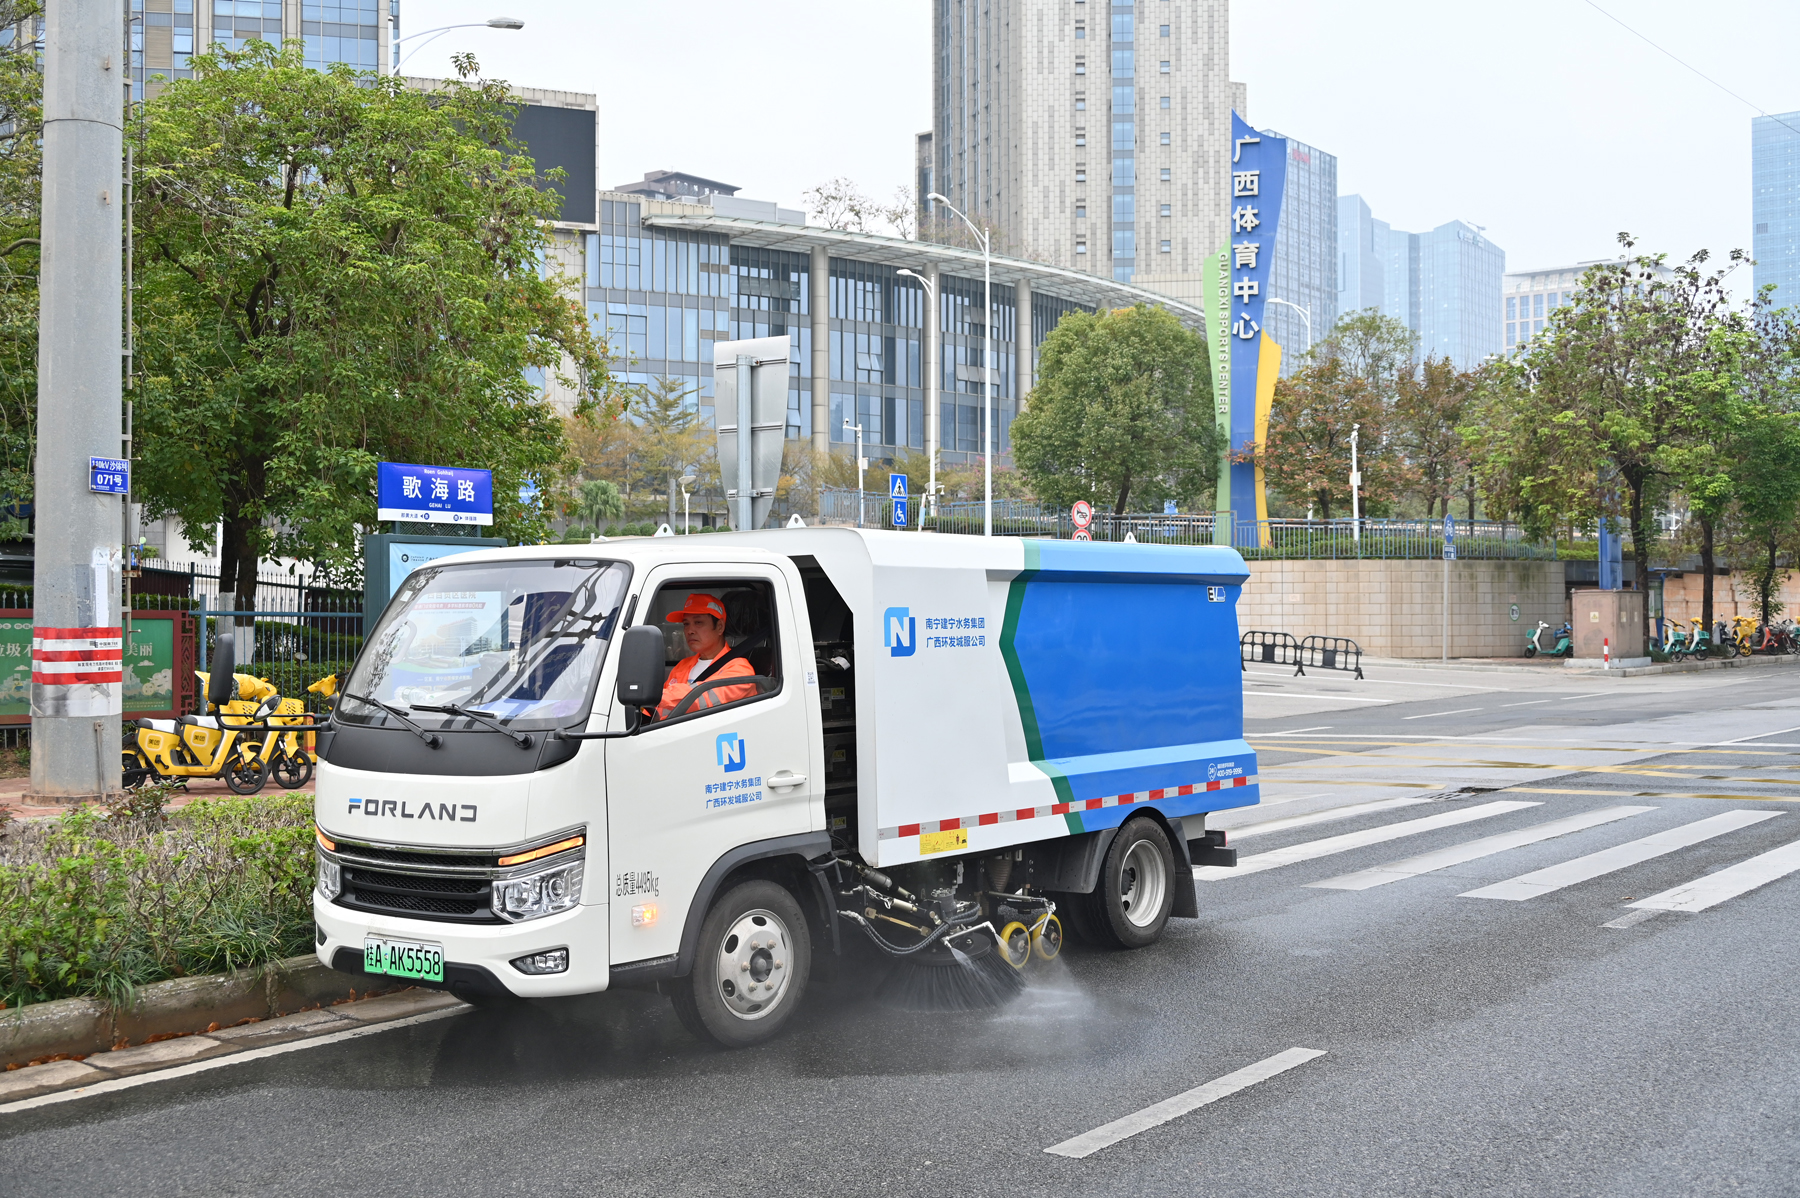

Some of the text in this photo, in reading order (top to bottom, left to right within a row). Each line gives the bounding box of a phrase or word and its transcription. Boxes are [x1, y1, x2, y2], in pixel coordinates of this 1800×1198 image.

[1232, 134, 1260, 340] 广西体育中心
[1218, 252, 1229, 414] GUANGXI SPORTS CENTER
[97, 474, 122, 487] 071号
[402, 476, 475, 502] 歌海路
[925, 617, 985, 630] 南宁建宁水务集团
[926, 635, 985, 648] 广西环发城服公司
[705, 776, 762, 794] 南宁建宁水务集团
[706, 791, 762, 809] 广西环发城服公司
[348, 798, 478, 823] FORLAND
